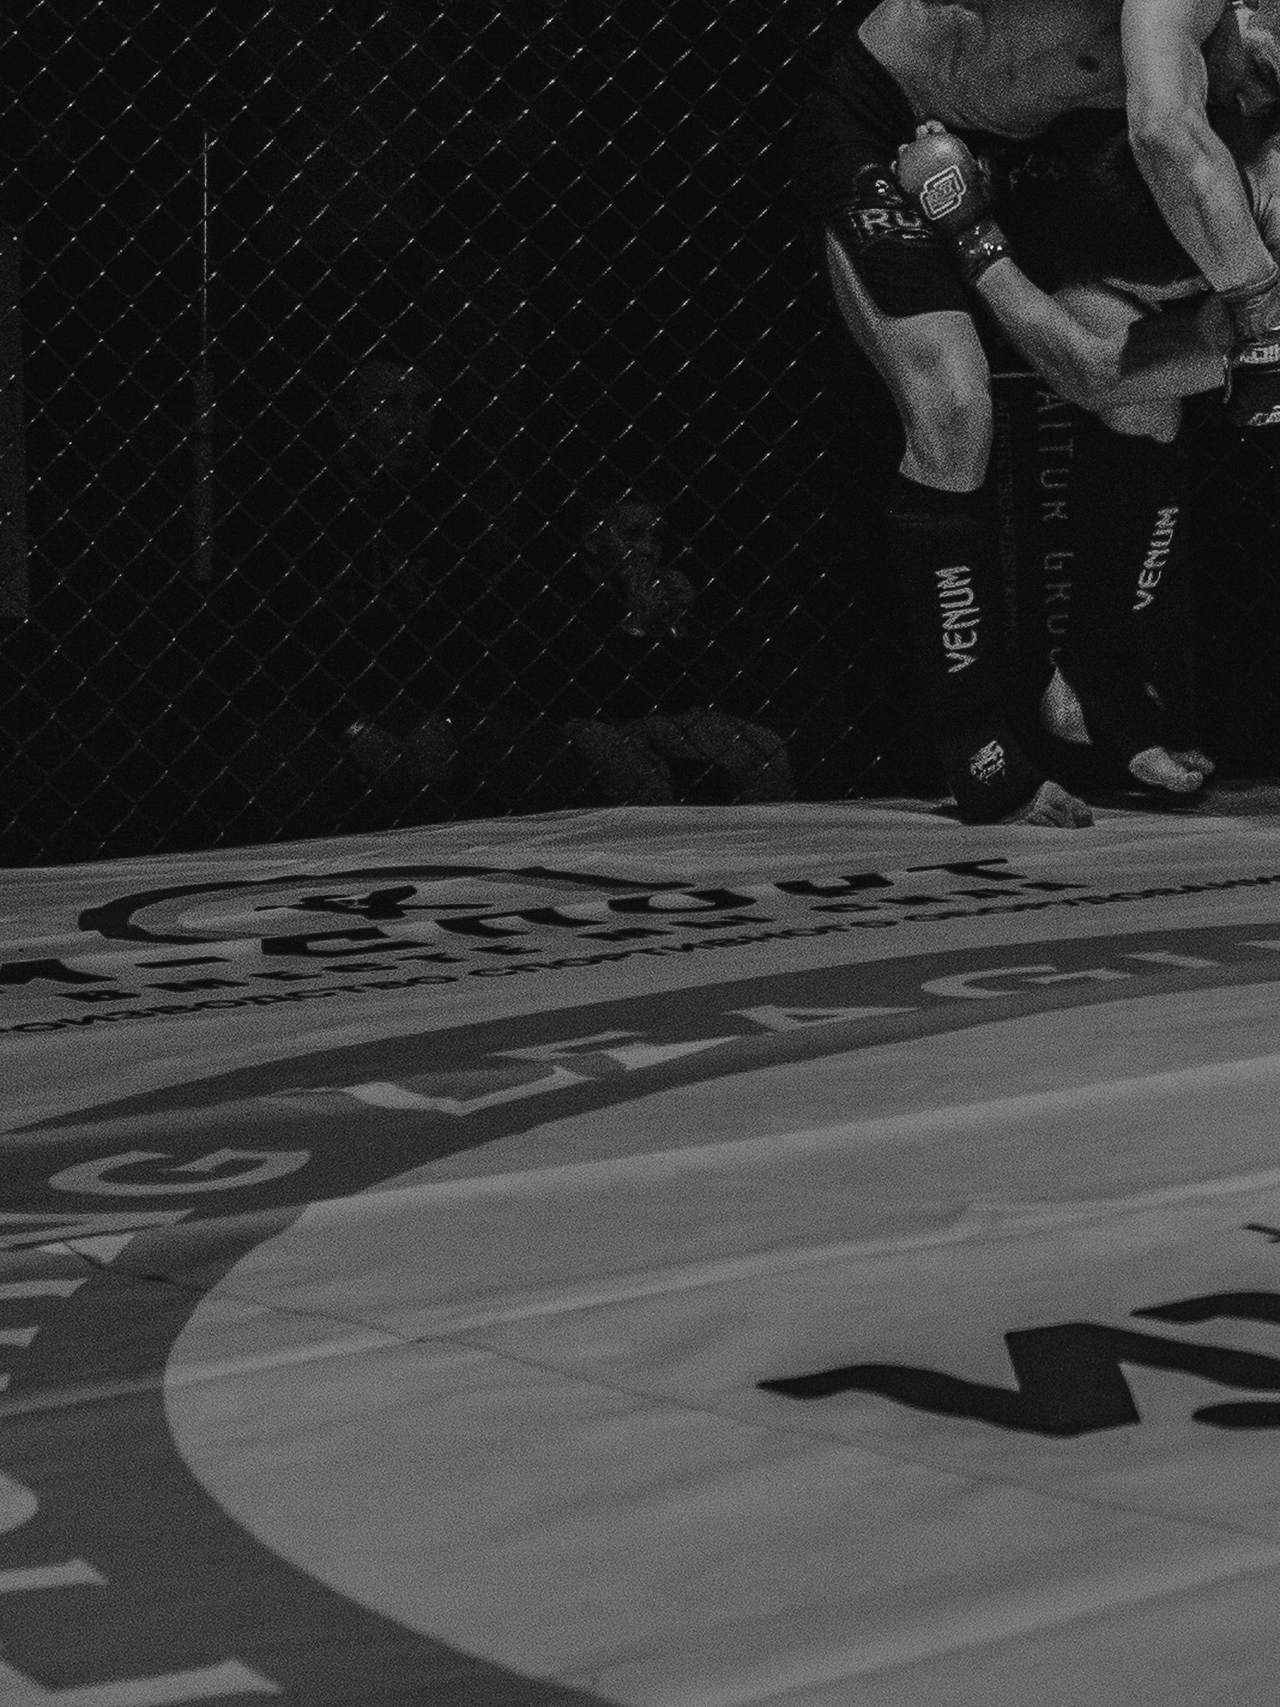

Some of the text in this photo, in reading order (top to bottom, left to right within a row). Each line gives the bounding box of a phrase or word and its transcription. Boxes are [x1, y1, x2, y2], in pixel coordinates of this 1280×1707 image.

[1131, 506, 1180, 612] VENUM
[934, 565, 983, 673] VENUM
[0, 975, 459, 1033] ОИЗВОДСТВО
